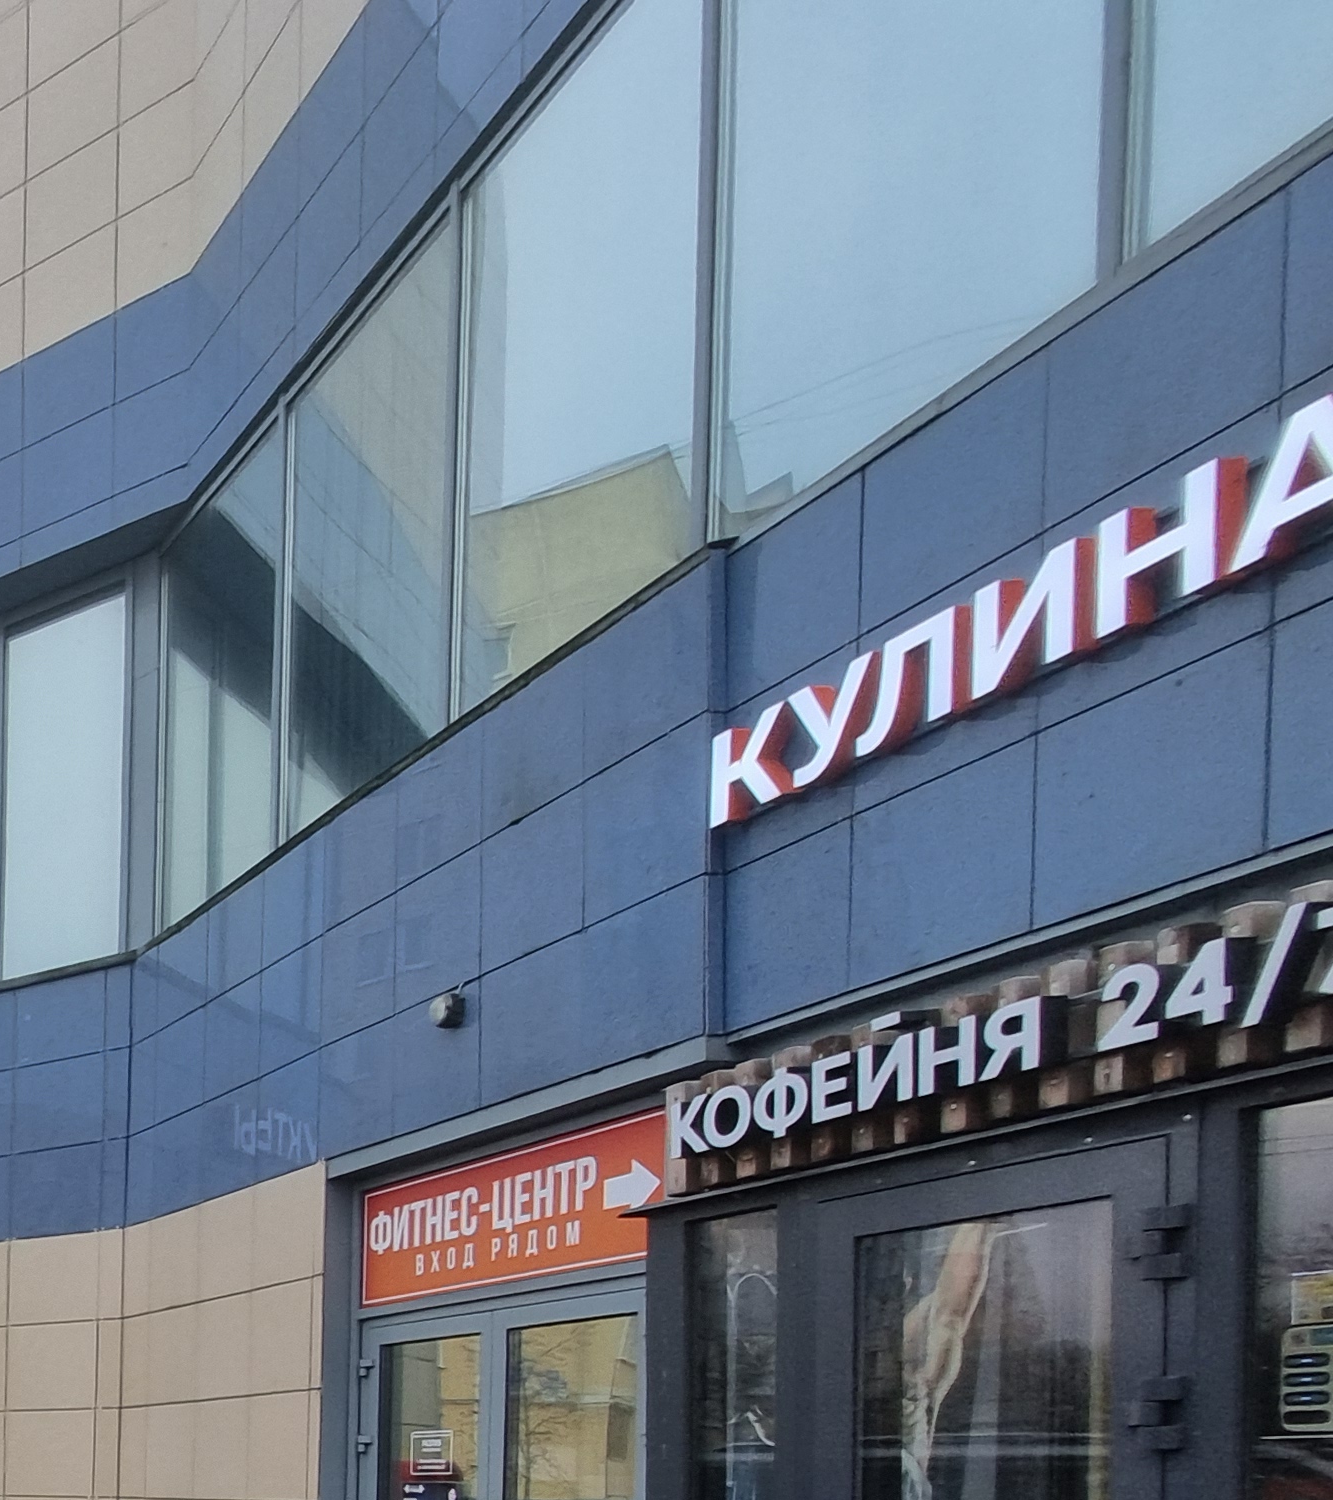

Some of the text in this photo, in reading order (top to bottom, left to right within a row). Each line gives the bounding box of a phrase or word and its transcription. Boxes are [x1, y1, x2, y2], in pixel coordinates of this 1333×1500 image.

[670, 996, 1042, 1160] КОФЕЙНЯ
[369, 1155, 598, 1256] ФИТНЕС-ЦЕНТР
[415, 1220, 581, 1276] ВХОД РЯДОМ
